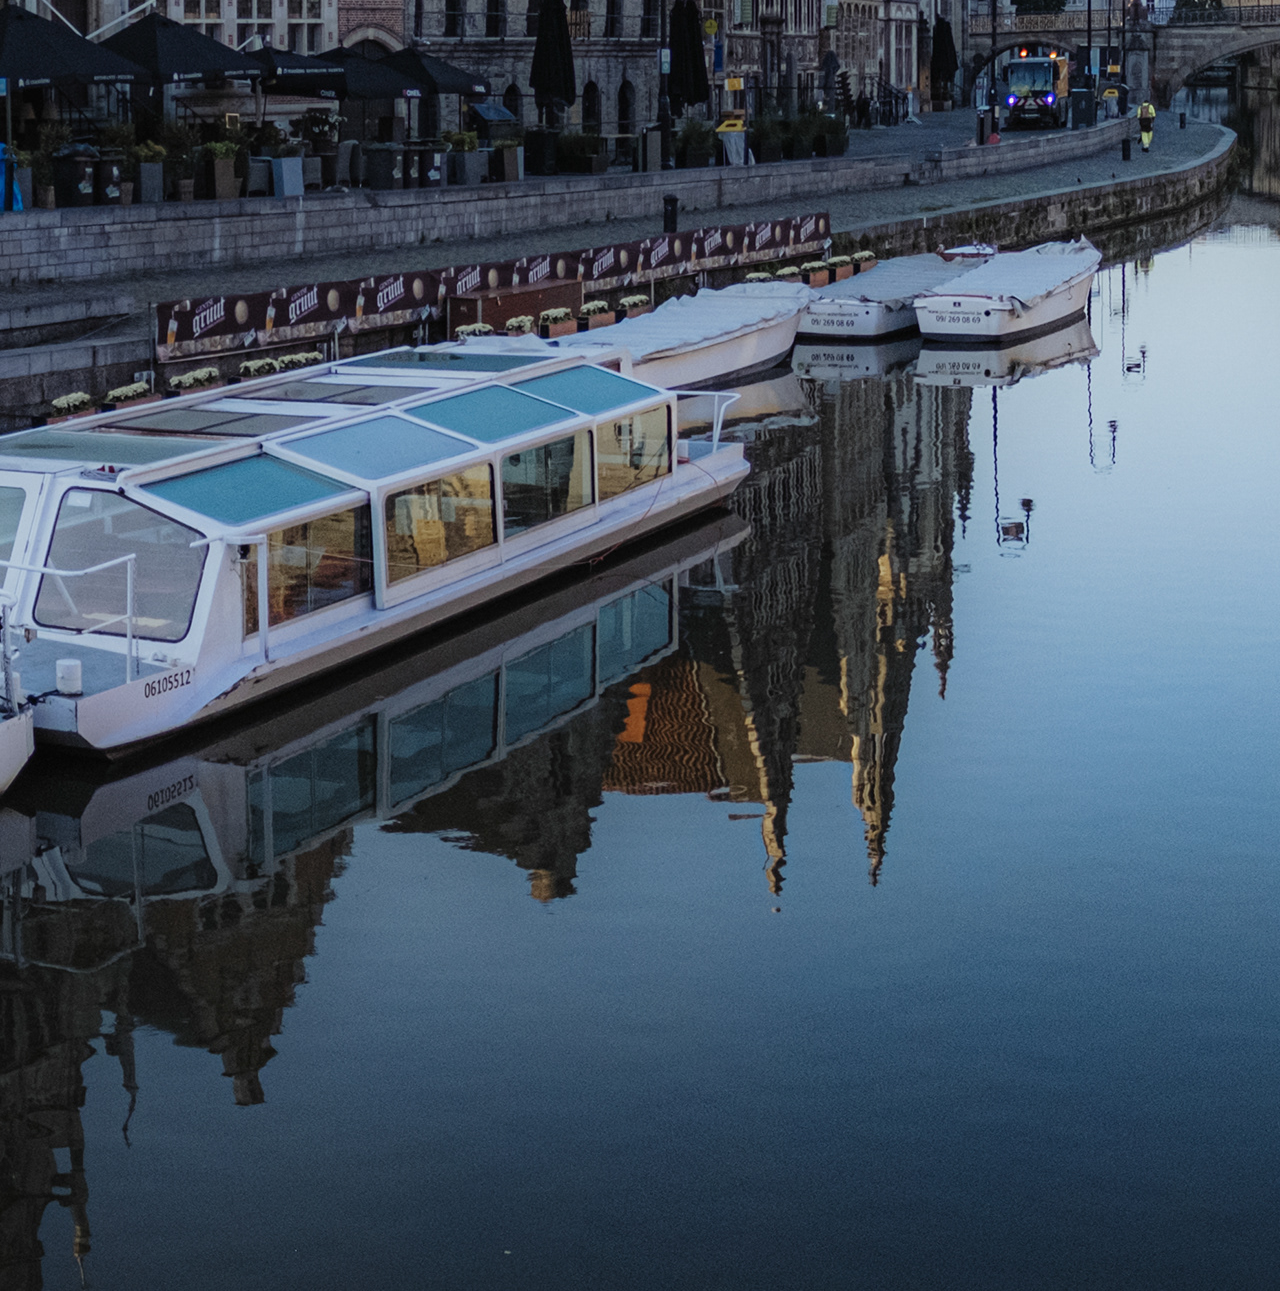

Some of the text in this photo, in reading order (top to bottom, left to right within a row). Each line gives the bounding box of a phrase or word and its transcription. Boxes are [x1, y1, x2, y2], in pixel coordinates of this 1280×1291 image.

[192, 296, 226, 339] gruut
[288, 284, 319, 325] gruut
[823, 318, 835, 327] 269
[835, 319, 845, 327] 08
[846, 319, 855, 328] 69
[948, 315, 960, 324] 269
[961, 316, 971, 324] 08
[971, 316, 981, 324] 69
[144, 669, 191, 698] 06105512
